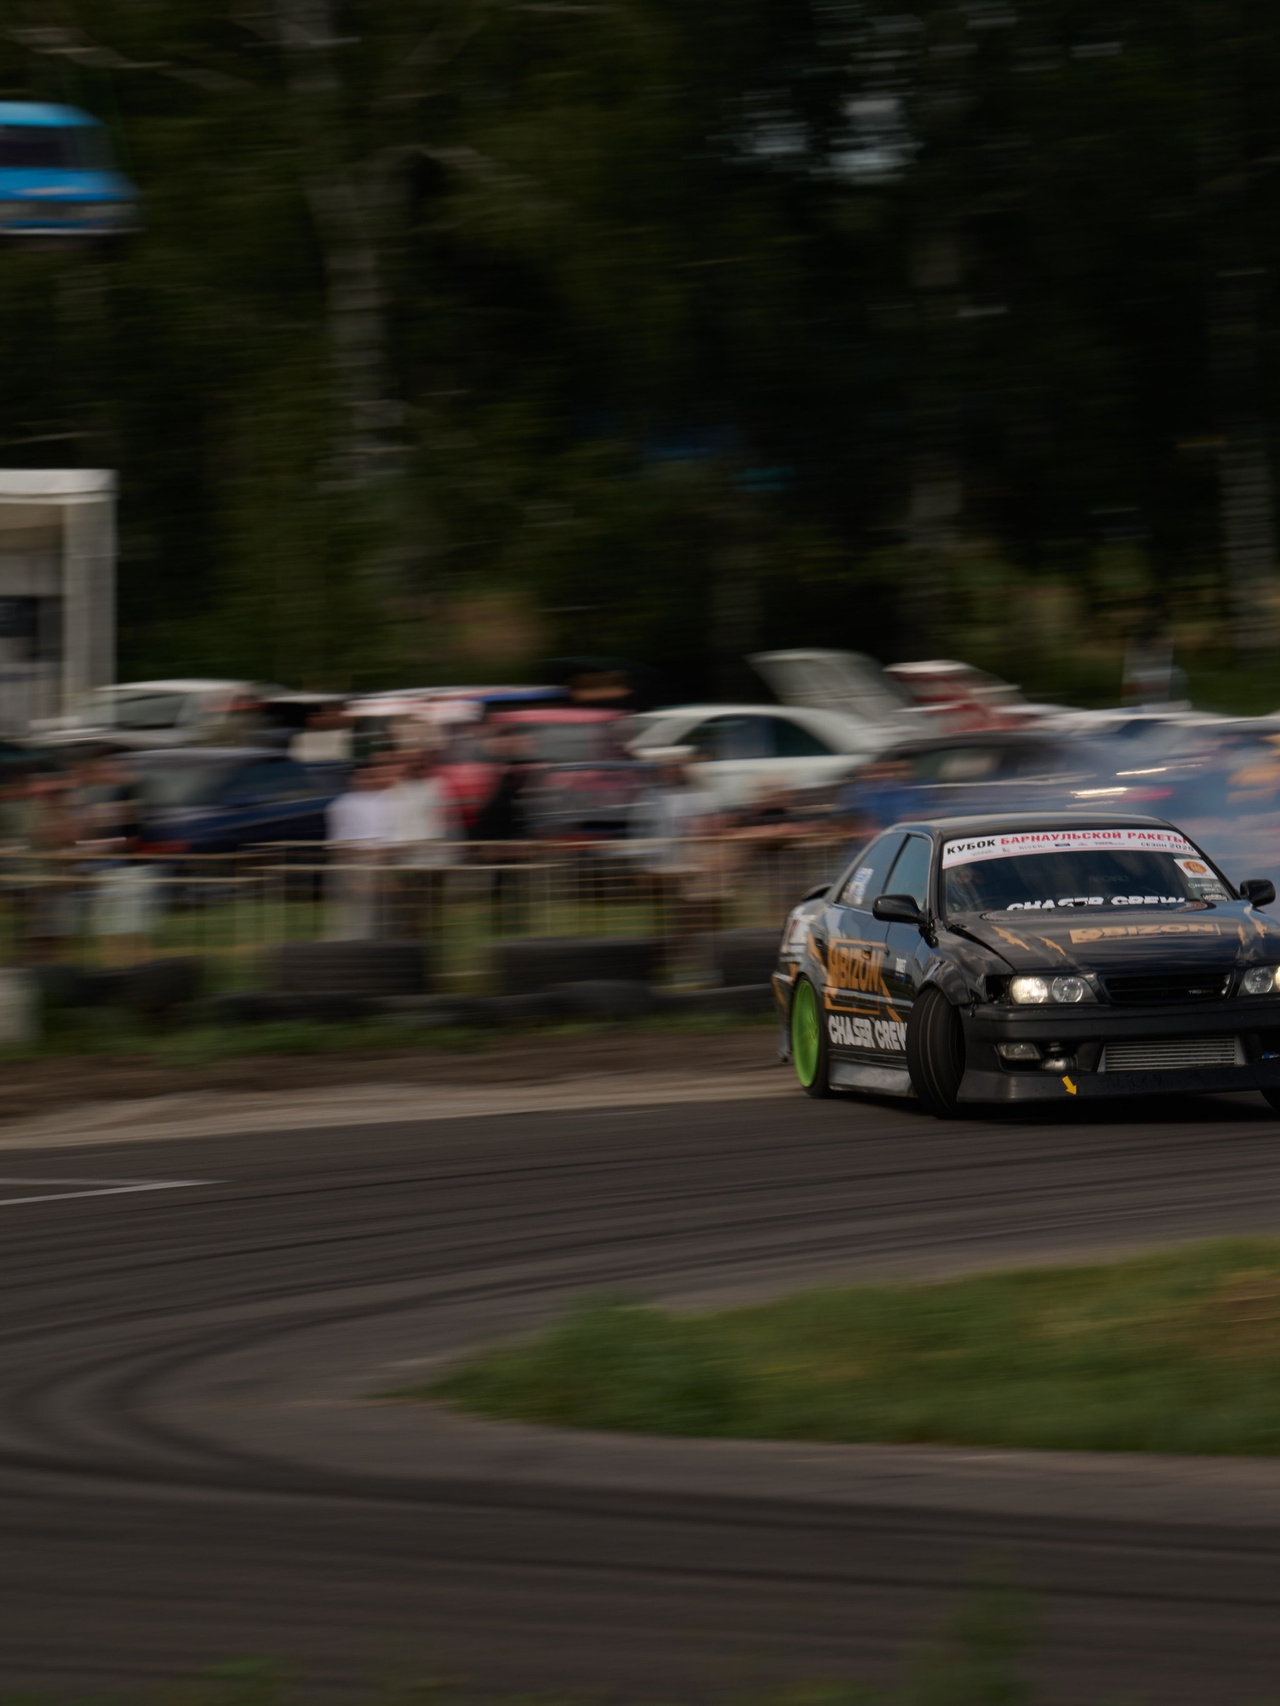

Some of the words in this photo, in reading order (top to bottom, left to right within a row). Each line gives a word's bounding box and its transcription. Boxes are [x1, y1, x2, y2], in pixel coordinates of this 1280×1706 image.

[947, 839, 996, 855] КУБОК
[1000, 831, 1122, 845] БАРНАУЛЬСКОЙ
[1127, 832, 1188, 844] РАКЕТЫ
[828, 1014, 876, 1049] CHASER
